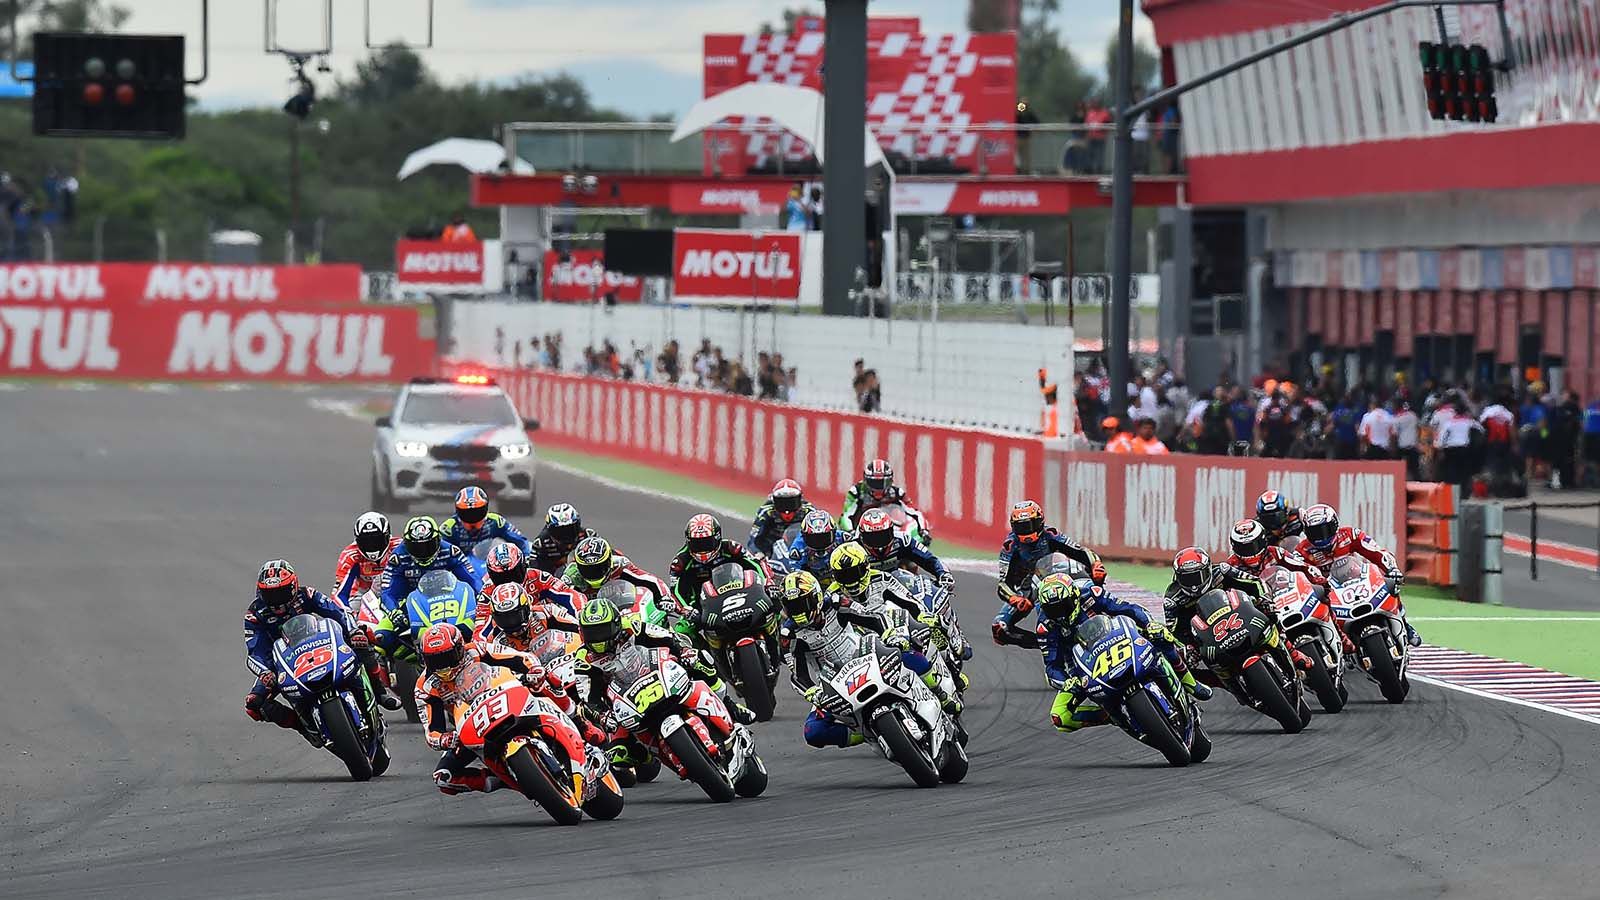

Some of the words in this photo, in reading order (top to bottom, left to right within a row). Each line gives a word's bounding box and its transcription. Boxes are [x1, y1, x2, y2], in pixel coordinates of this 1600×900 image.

[978, 190, 1040, 207] MOTUL
[403, 252, 479, 274] MOTUL
[680, 249, 794, 279] MOTUL
[143, 266, 278, 300] MOTUL
[0, 307, 120, 371] TUL
[167, 310, 393, 375] MOTUL
[1306, 596, 1318, 608] TIM
[1342, 584, 1370, 605] 04
[1377, 588, 1389, 600] TIM
[430, 600, 460, 622] 29
[1335, 608, 1349, 616] TIM
[1213, 613, 1244, 642] 94
[294, 638, 332, 656] movistar
[1092, 633, 1127, 657] movistar
[293, 643, 334, 681] 25
[1092, 638, 1133, 680] 46
[845, 662, 872, 697] 17
[472, 693, 510, 738] 93
